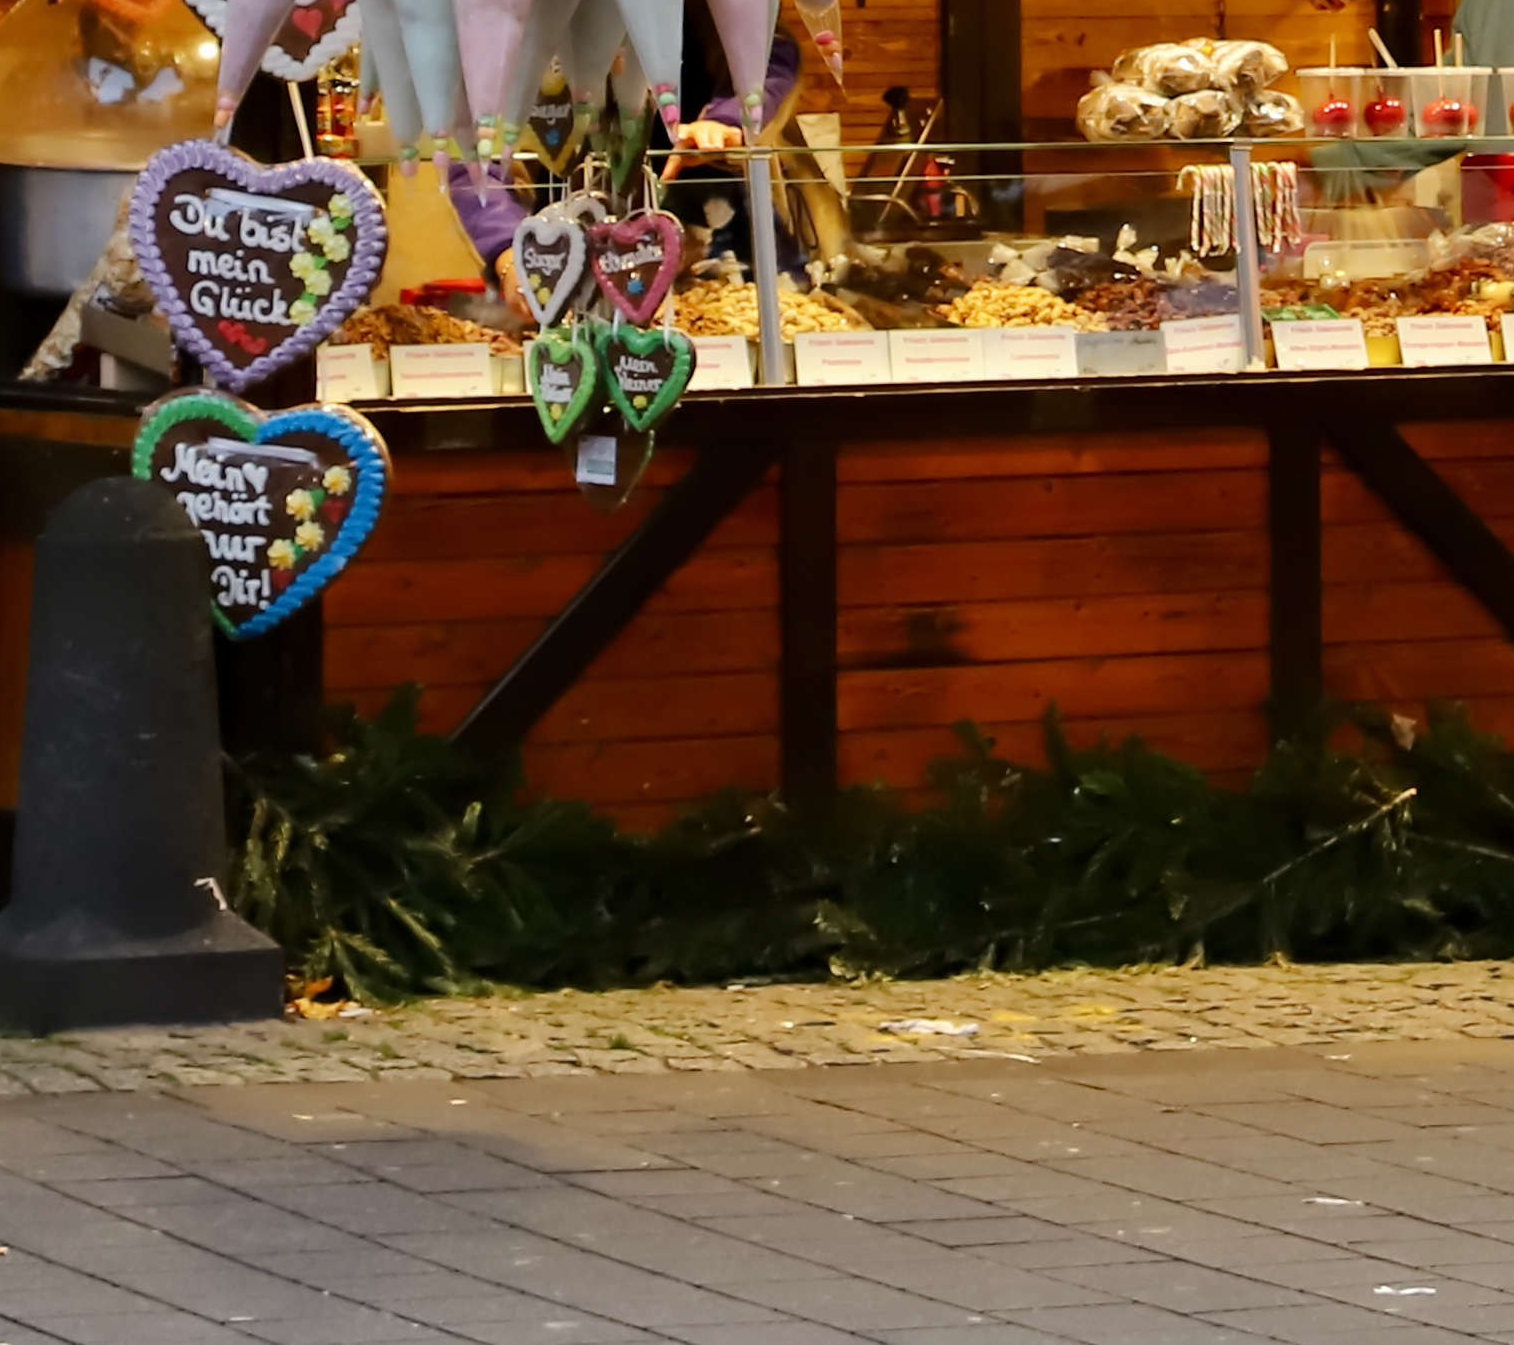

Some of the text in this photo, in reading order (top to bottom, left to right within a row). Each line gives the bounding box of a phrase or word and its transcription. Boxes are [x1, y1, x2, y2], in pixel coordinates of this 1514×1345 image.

[169, 193, 308, 254] Du bist
[187, 248, 275, 285] mein
[188, 280, 292, 327] Glück
[159, 440, 244, 494] Mein
[211, 563, 272, 611] Dir!
